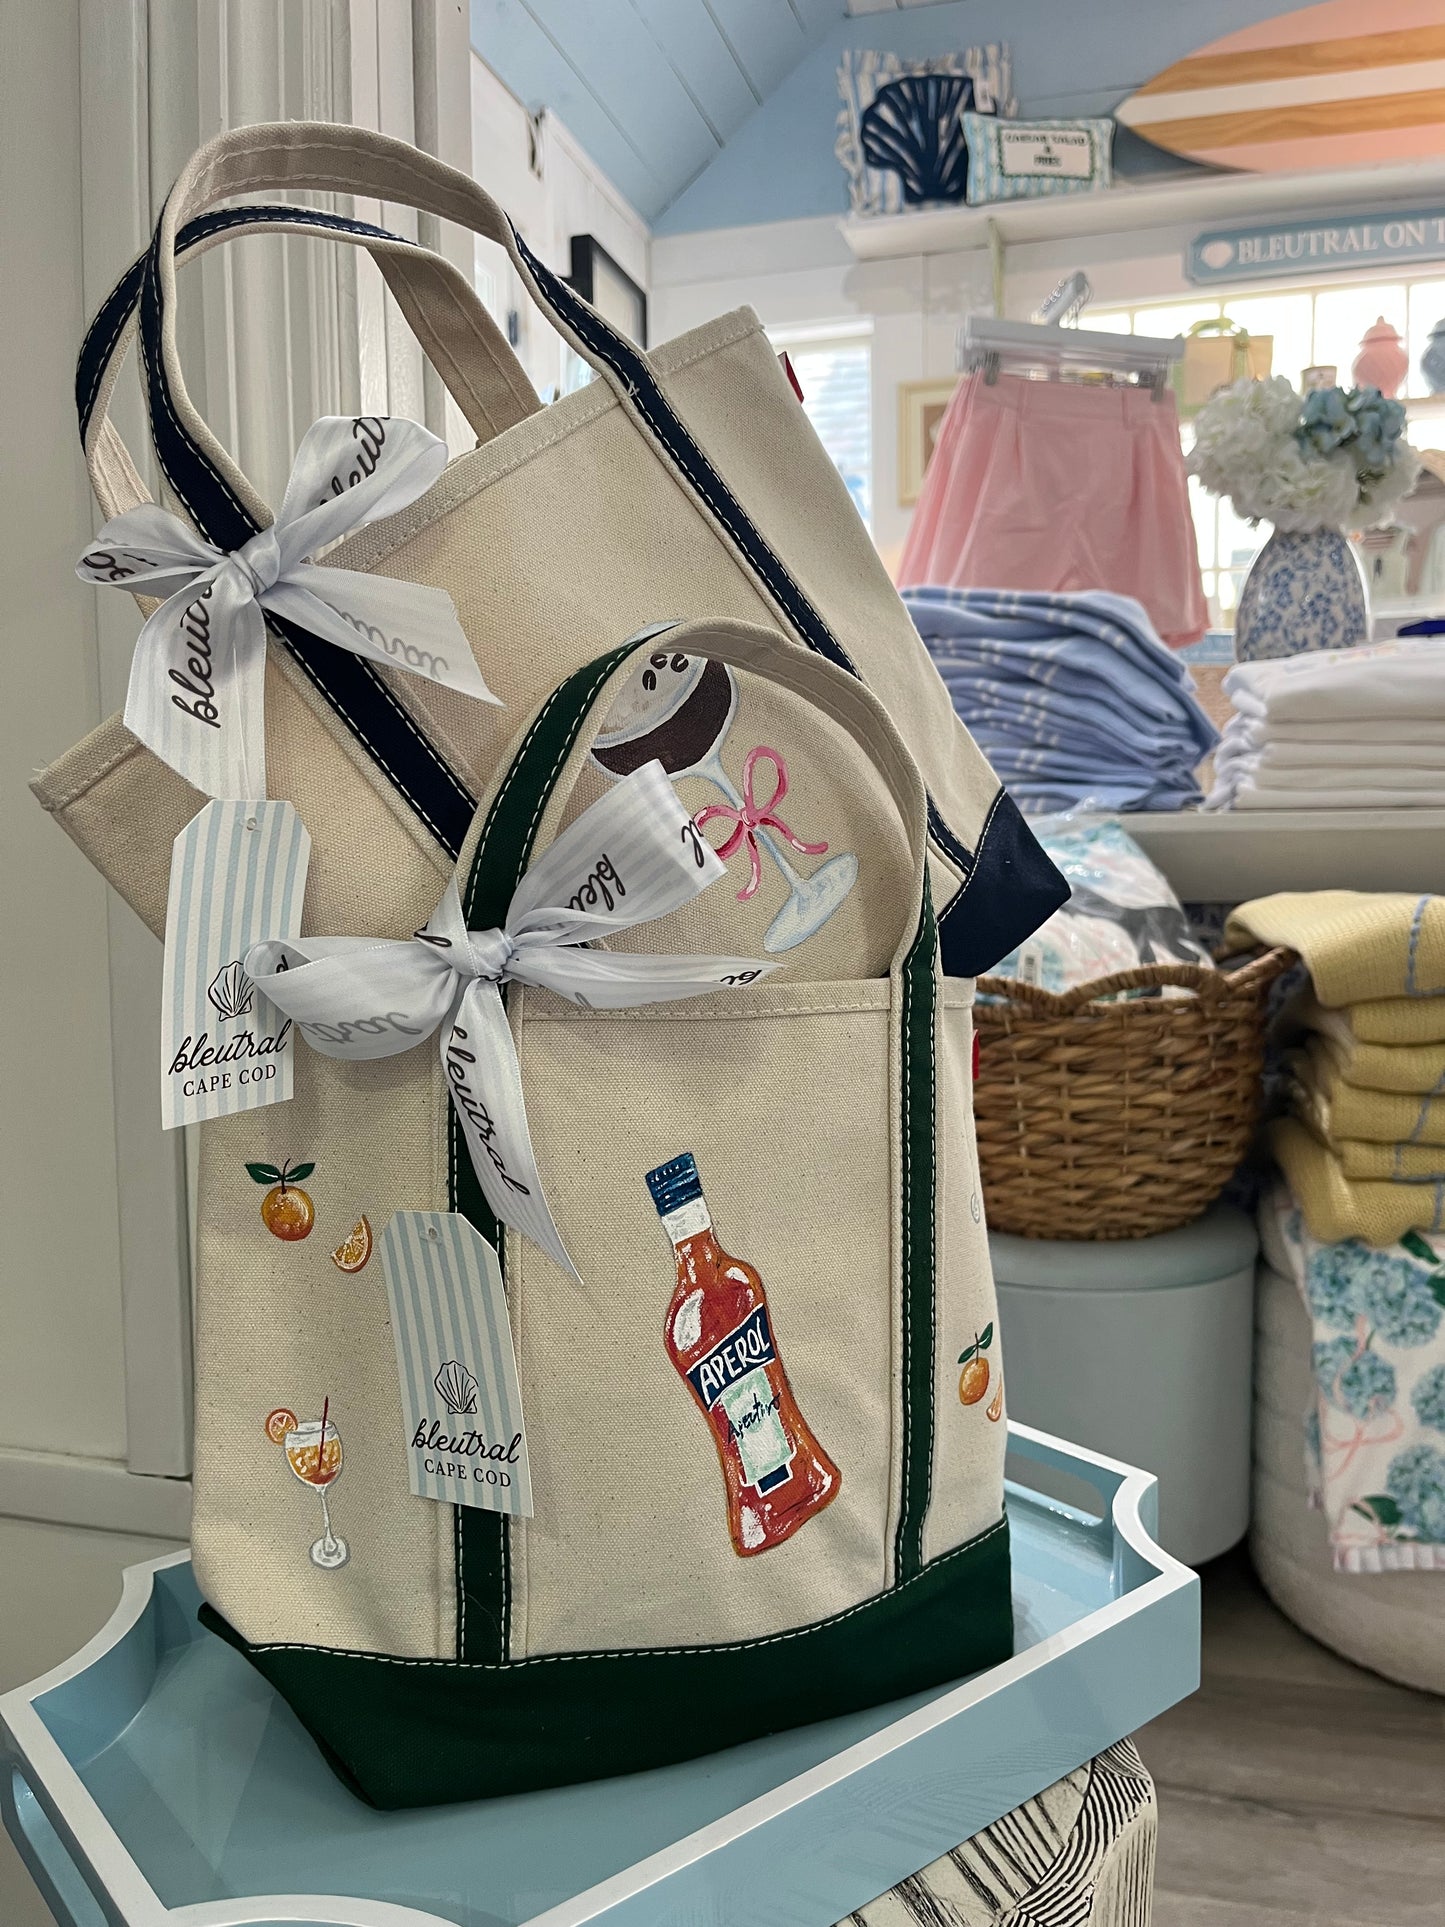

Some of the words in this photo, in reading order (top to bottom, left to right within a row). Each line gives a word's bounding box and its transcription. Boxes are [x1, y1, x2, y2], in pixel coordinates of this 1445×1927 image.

[1238, 224, 1379, 265] BLEUTRAL
[1383, 219, 1425, 249] ON
[168, 577, 221, 729] bleut
[168, 1018, 293, 1076] bleutral
[183, 1072, 232, 1097] CAPE
[239, 1064, 276, 1085] COD
[700, 1315, 770, 1405] APEROL
[411, 1418, 522, 1464] bleutral
[424, 1458, 467, 1480] CAPE
[473, 1467, 511, 1488] COD
